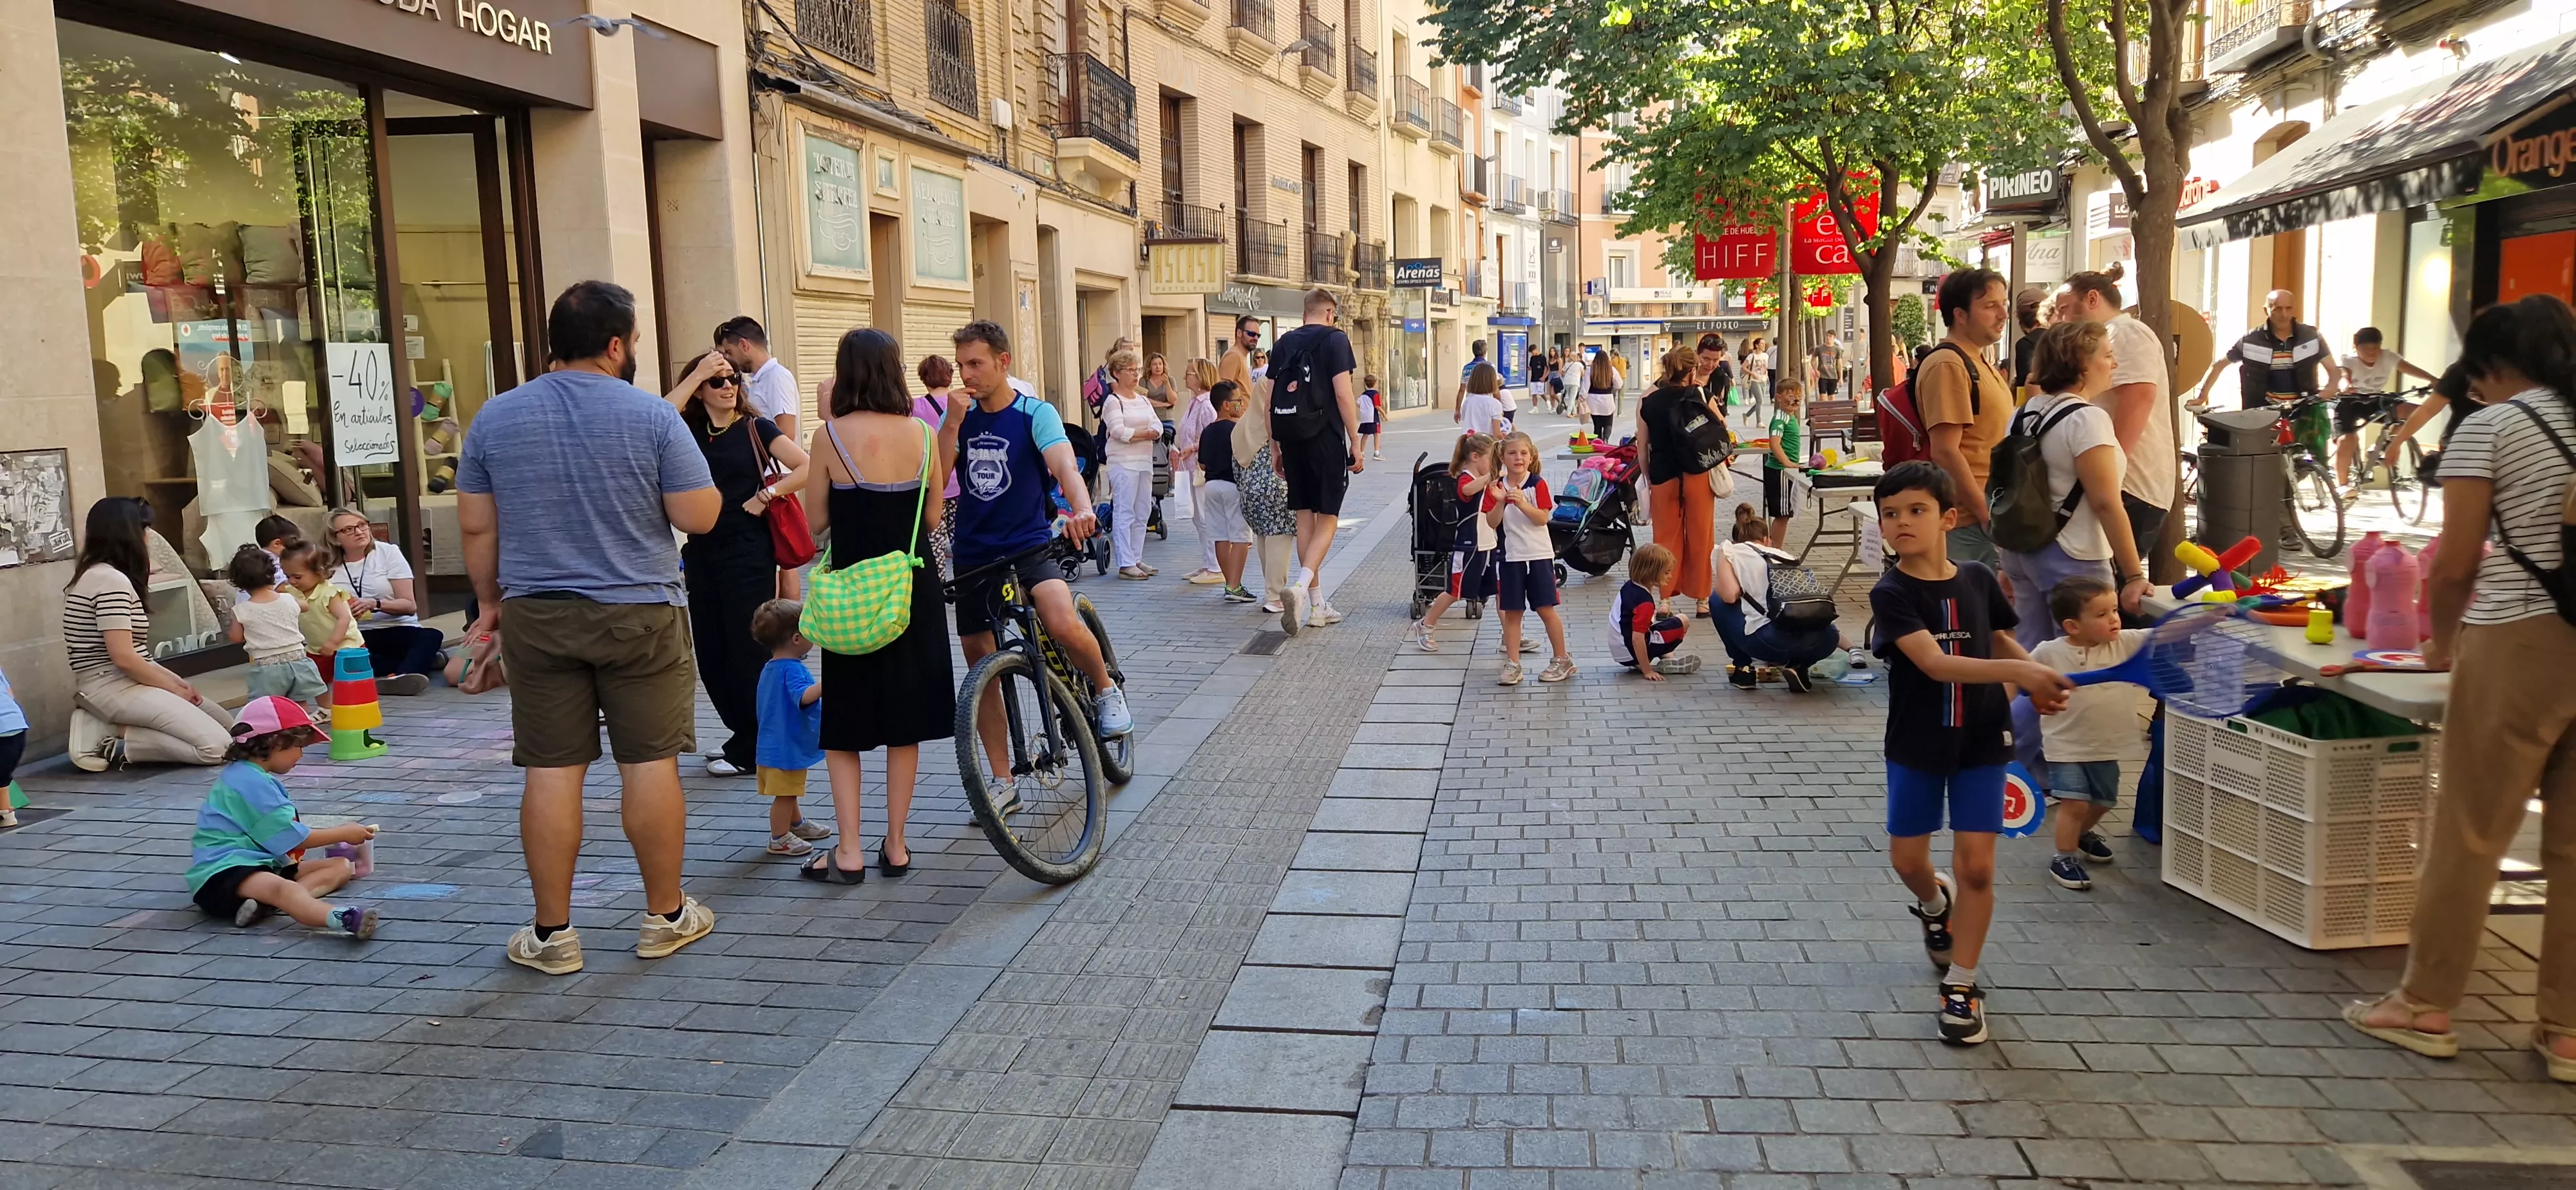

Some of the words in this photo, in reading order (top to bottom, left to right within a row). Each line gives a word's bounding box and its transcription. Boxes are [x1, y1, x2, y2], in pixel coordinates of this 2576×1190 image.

[455, 0, 552, 55] HOGAR
[1990, 169, 2052, 199] PIRINEO
[1155, 246, 1216, 283] ASCASO
[1703, 243, 1768, 269] HIFF
[1396, 267, 1441, 279] Arenas
[1710, 321, 1739, 330] FOSKO
[334, 401, 349, 428] En
[1274, 406, 1297, 415] hummel
